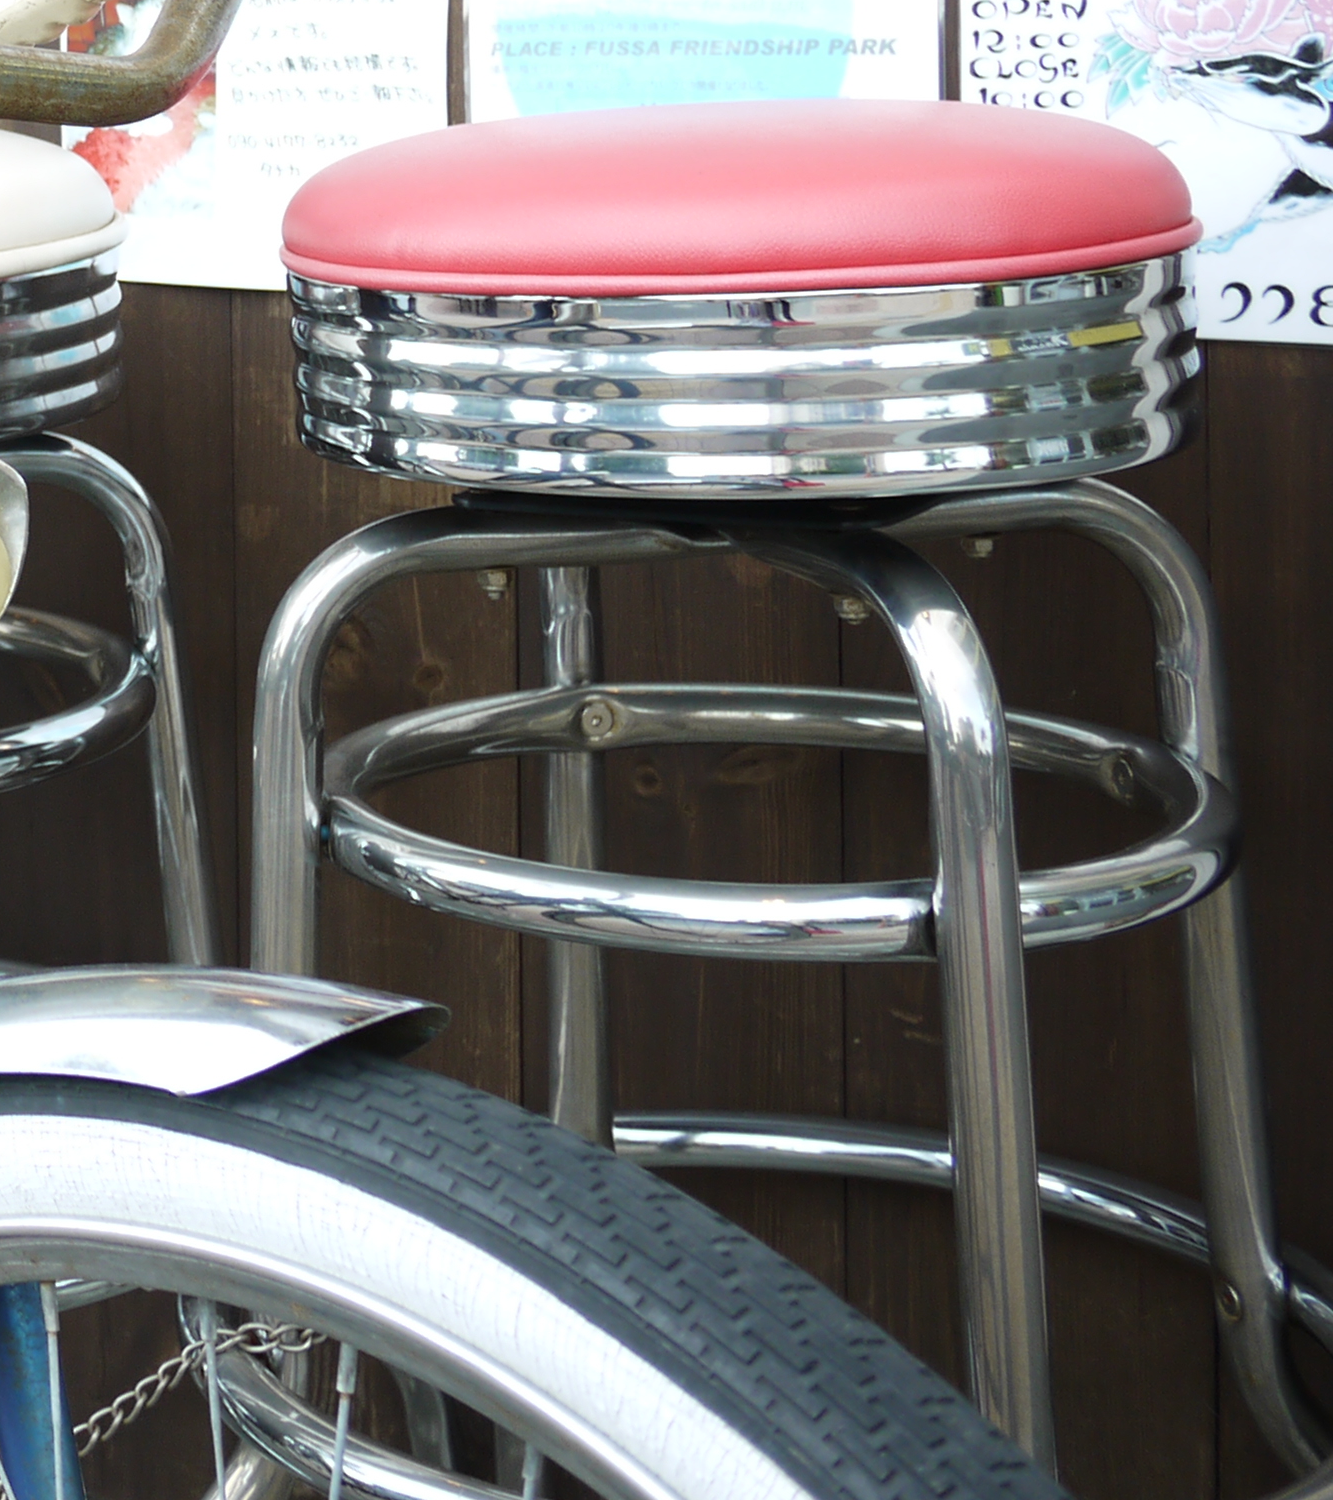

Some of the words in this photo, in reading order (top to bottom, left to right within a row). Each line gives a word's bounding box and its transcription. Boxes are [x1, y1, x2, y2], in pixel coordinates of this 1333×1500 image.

[490, 41, 564, 58] PLACE
[584, 39, 662, 57] FUSSA
[669, 38, 820, 56] FRIENDSHIP
[827, 37, 899, 56] PARK
[972, 29, 1080, 53] 12:00
[969, 56, 1080, 82] CLOSE
